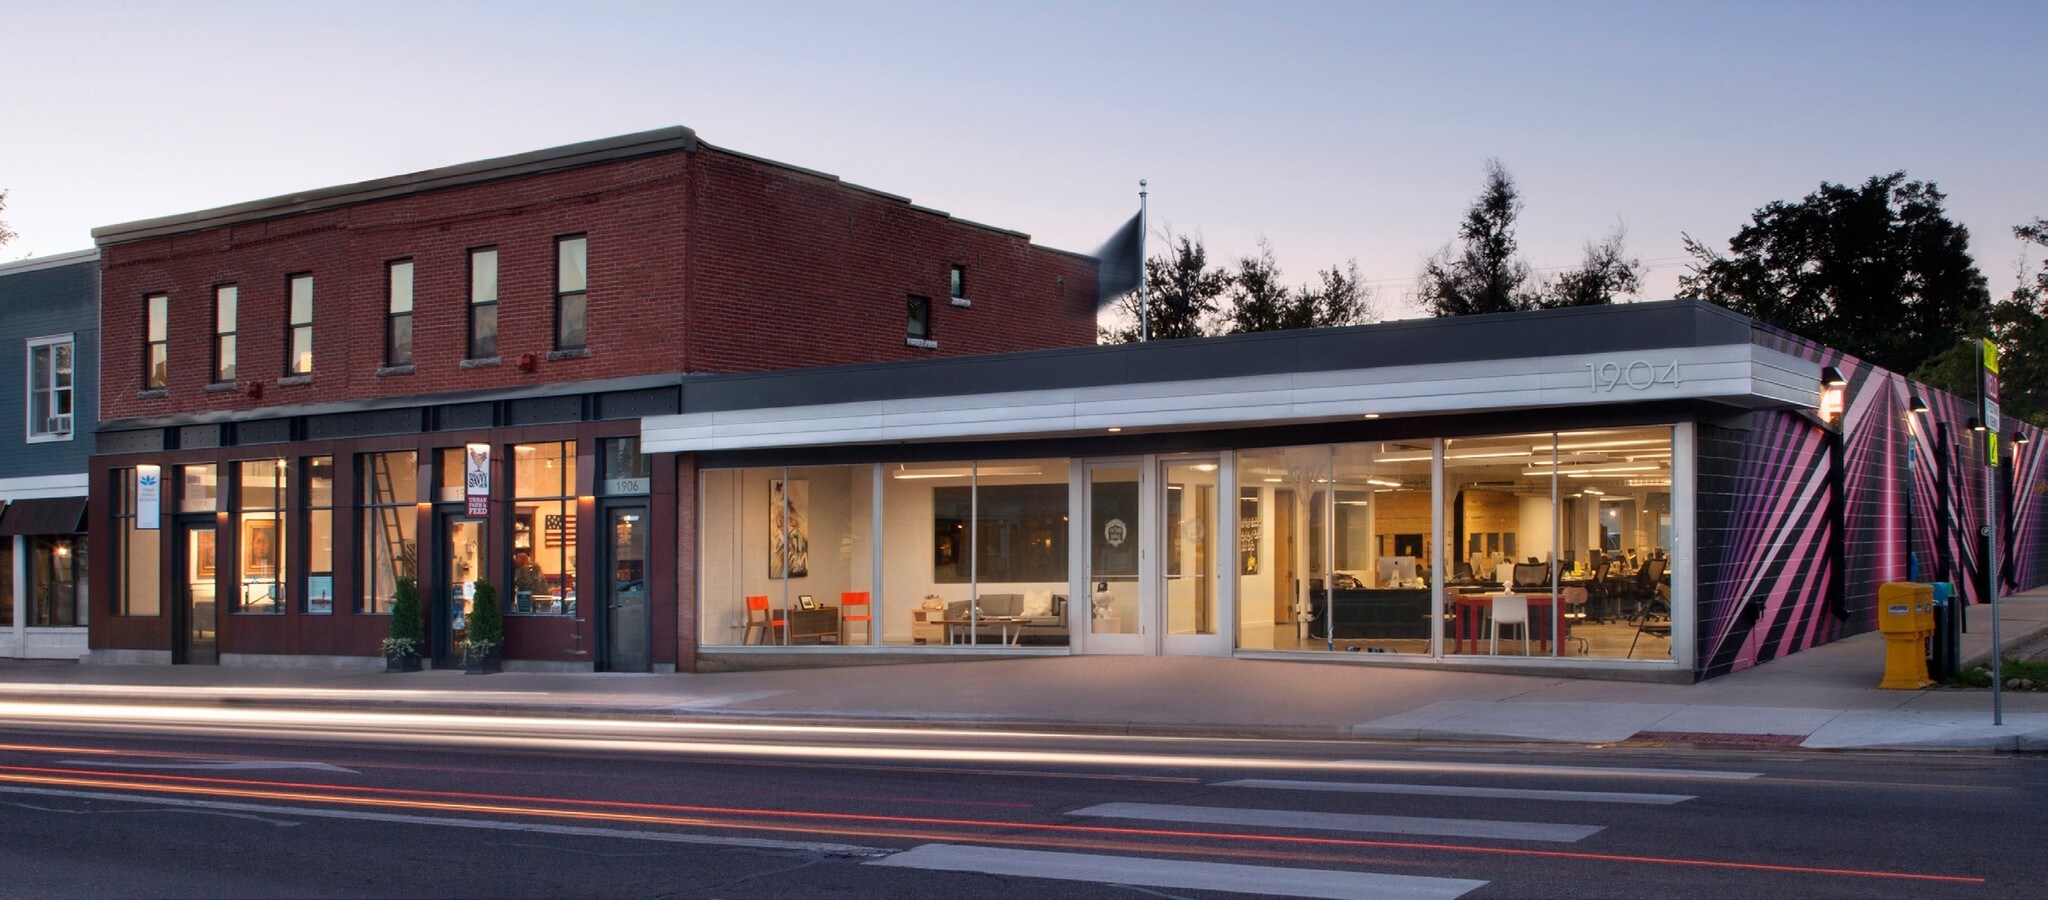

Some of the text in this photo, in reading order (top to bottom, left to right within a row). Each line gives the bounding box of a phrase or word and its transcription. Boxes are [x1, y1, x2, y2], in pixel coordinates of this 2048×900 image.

[1585, 358, 1683, 393] 1904
[469, 472, 487, 488] SAVVY
[616, 480, 639, 492] 1906
